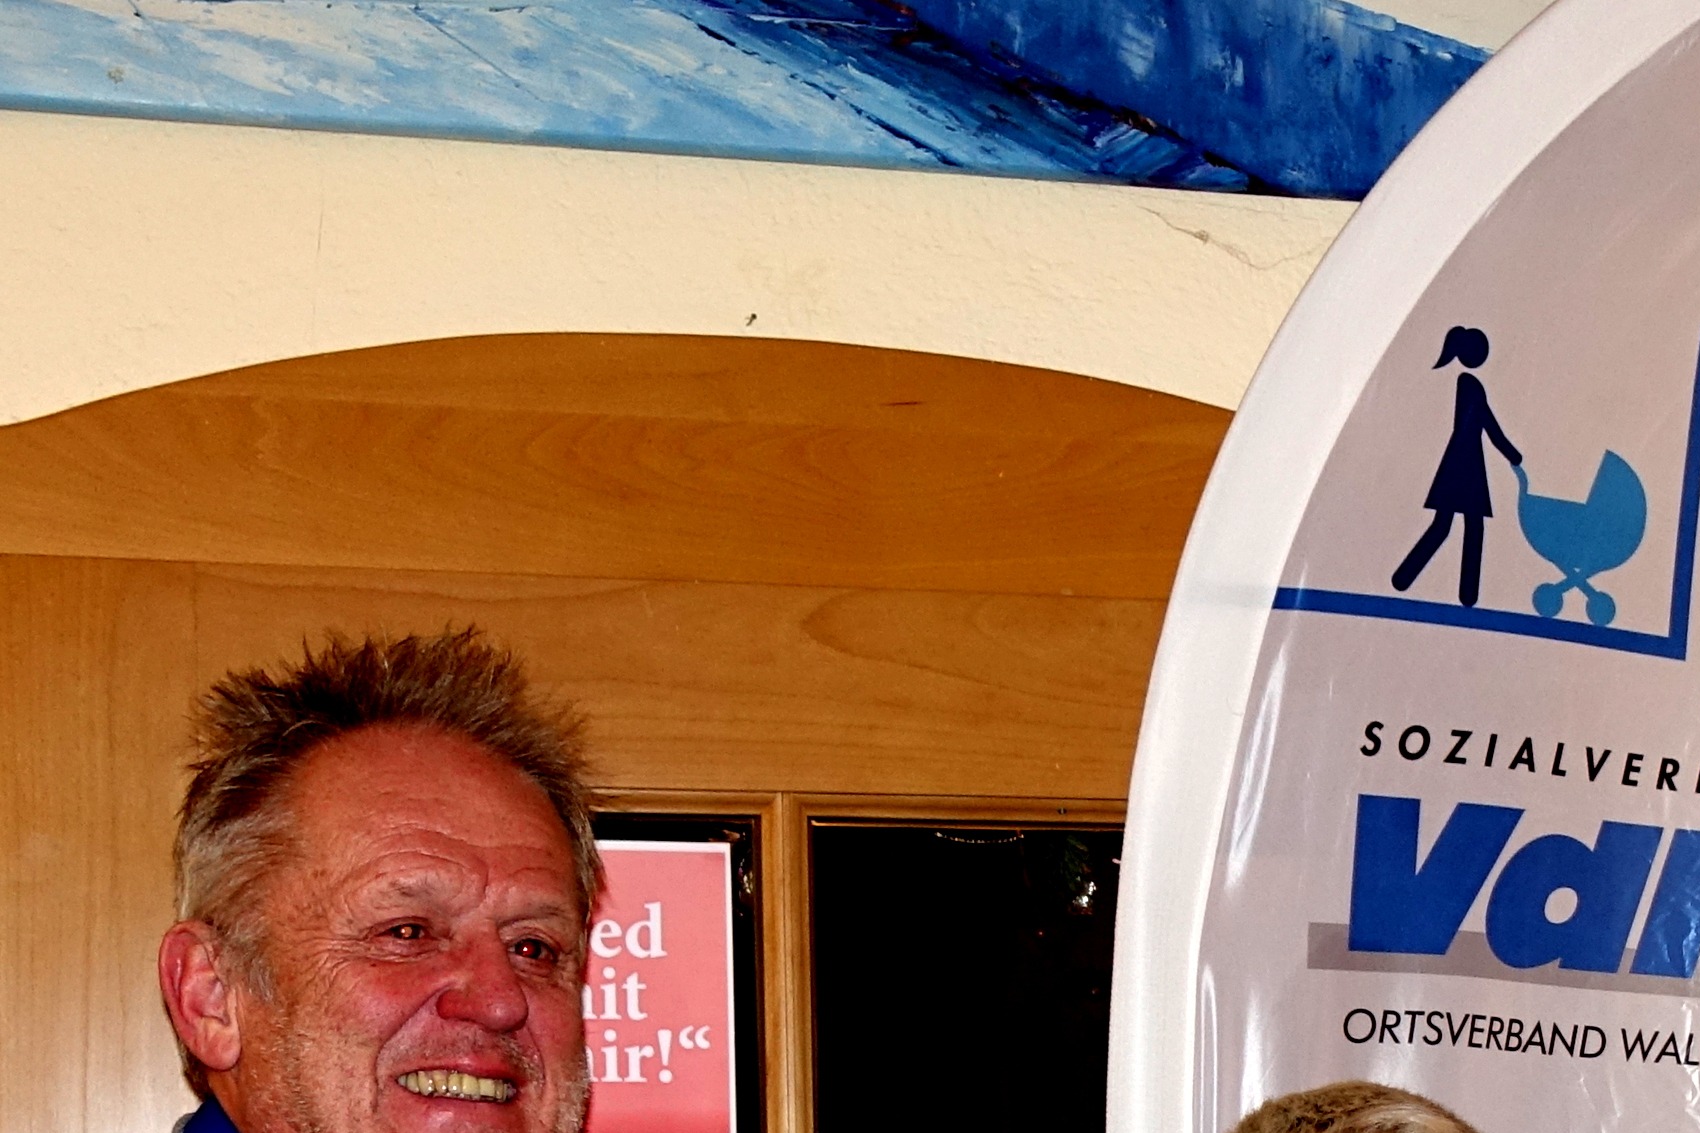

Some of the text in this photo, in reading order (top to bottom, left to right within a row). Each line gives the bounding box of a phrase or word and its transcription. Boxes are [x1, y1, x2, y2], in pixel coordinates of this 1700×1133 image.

[590, 901, 668, 959] ed
[585, 1025, 711, 1084] ir!“
[1342, 1008, 1607, 1059] ORTSVERBAND
